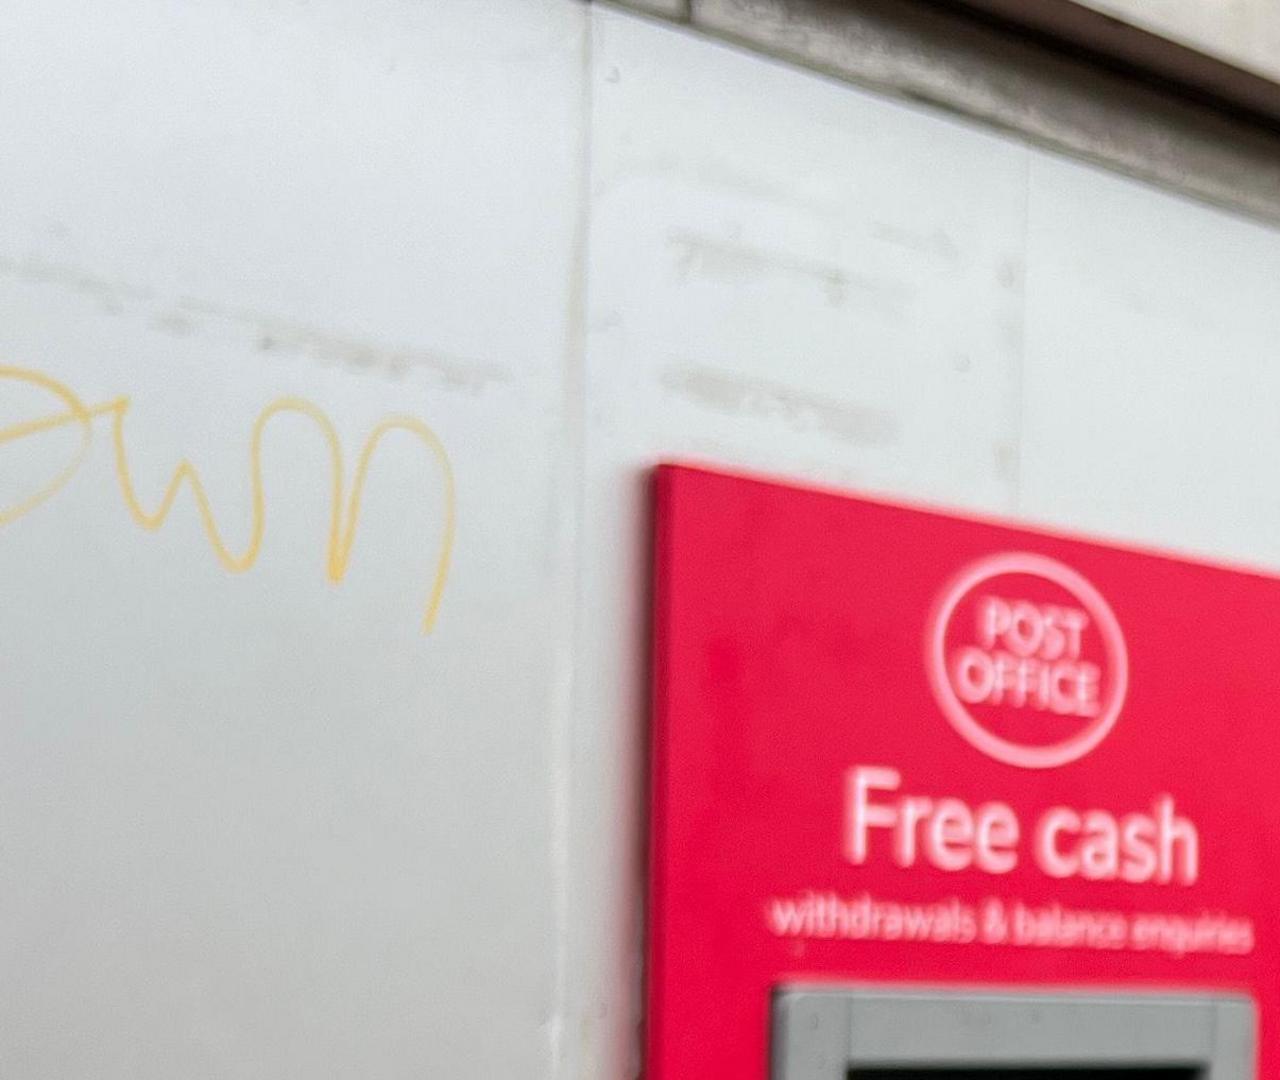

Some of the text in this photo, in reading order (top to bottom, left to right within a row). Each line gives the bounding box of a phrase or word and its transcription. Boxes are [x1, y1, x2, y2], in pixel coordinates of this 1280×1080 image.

[978, 596, 1088, 661] POST
[955, 646, 1101, 719] OFFICE
[845, 765, 1200, 886] Free cash
[769, 890, 1255, 959] withdrawals & balance enquiries
